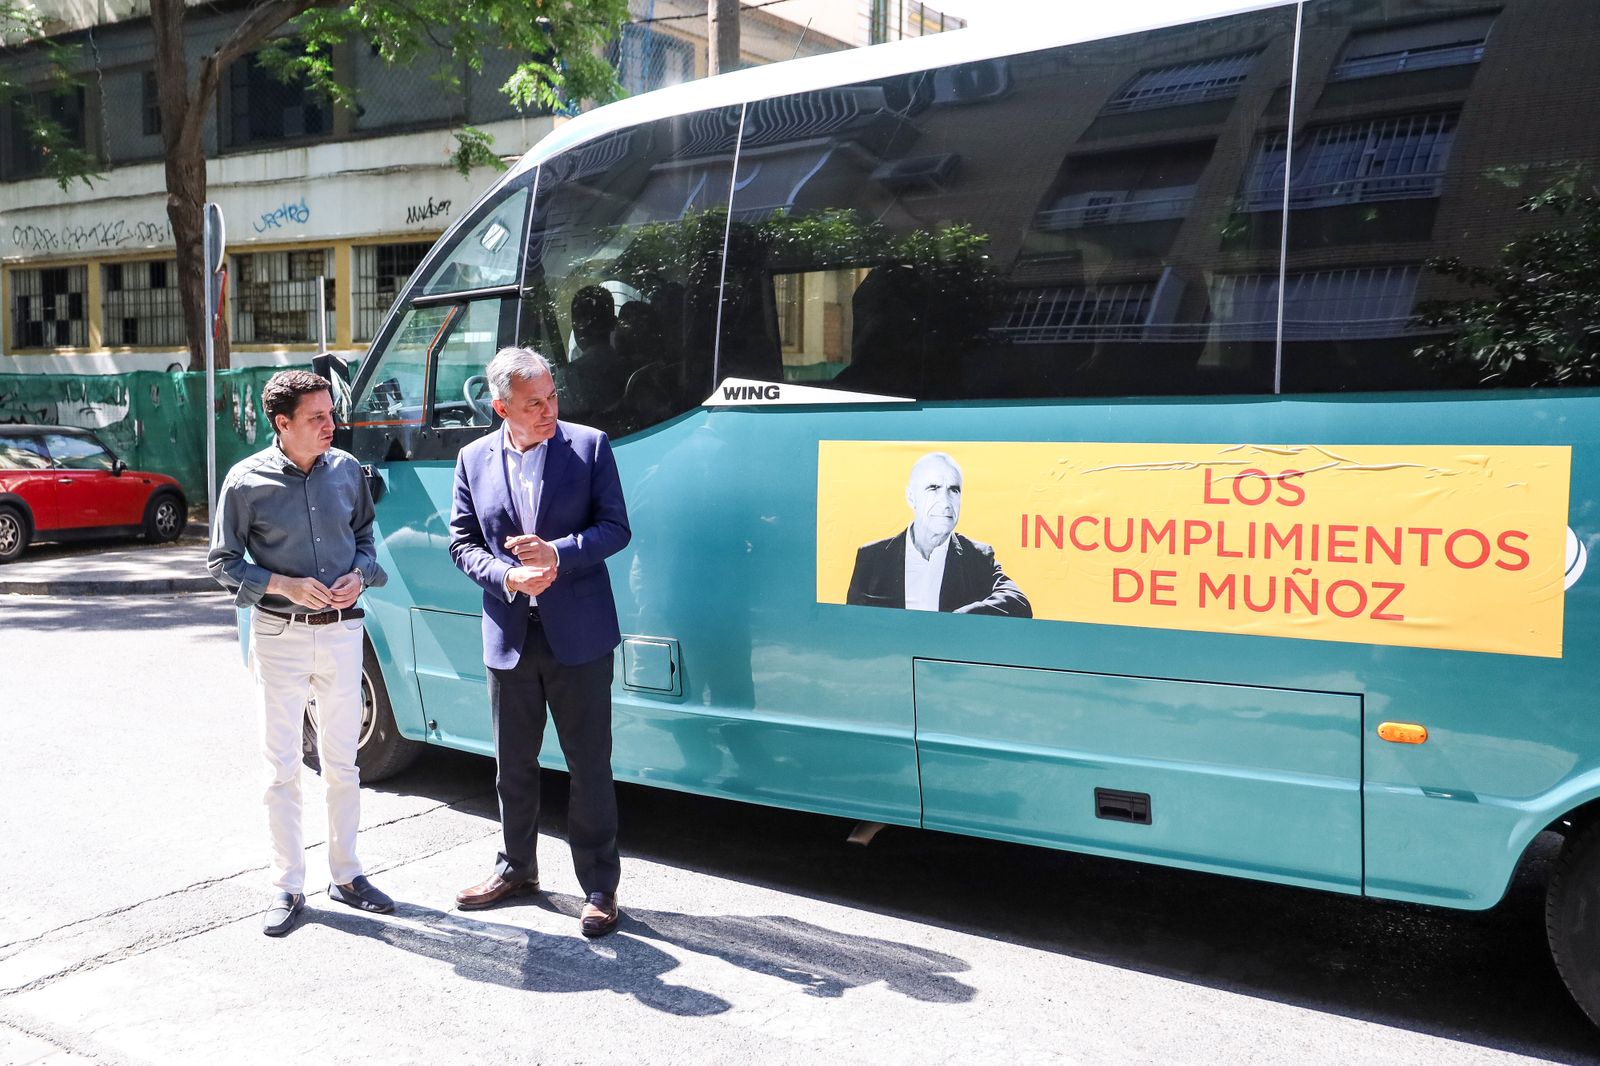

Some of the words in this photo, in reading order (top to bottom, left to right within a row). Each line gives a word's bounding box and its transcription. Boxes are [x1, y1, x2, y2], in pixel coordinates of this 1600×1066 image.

[723, 385, 780, 400] WING
[1203, 467, 1305, 507] LOS
[1021, 514, 1530, 572] INCUMPLIMIENTOS
[1112, 567, 1178, 607] DE
[1198, 567, 1405, 621] MUÑOZ
